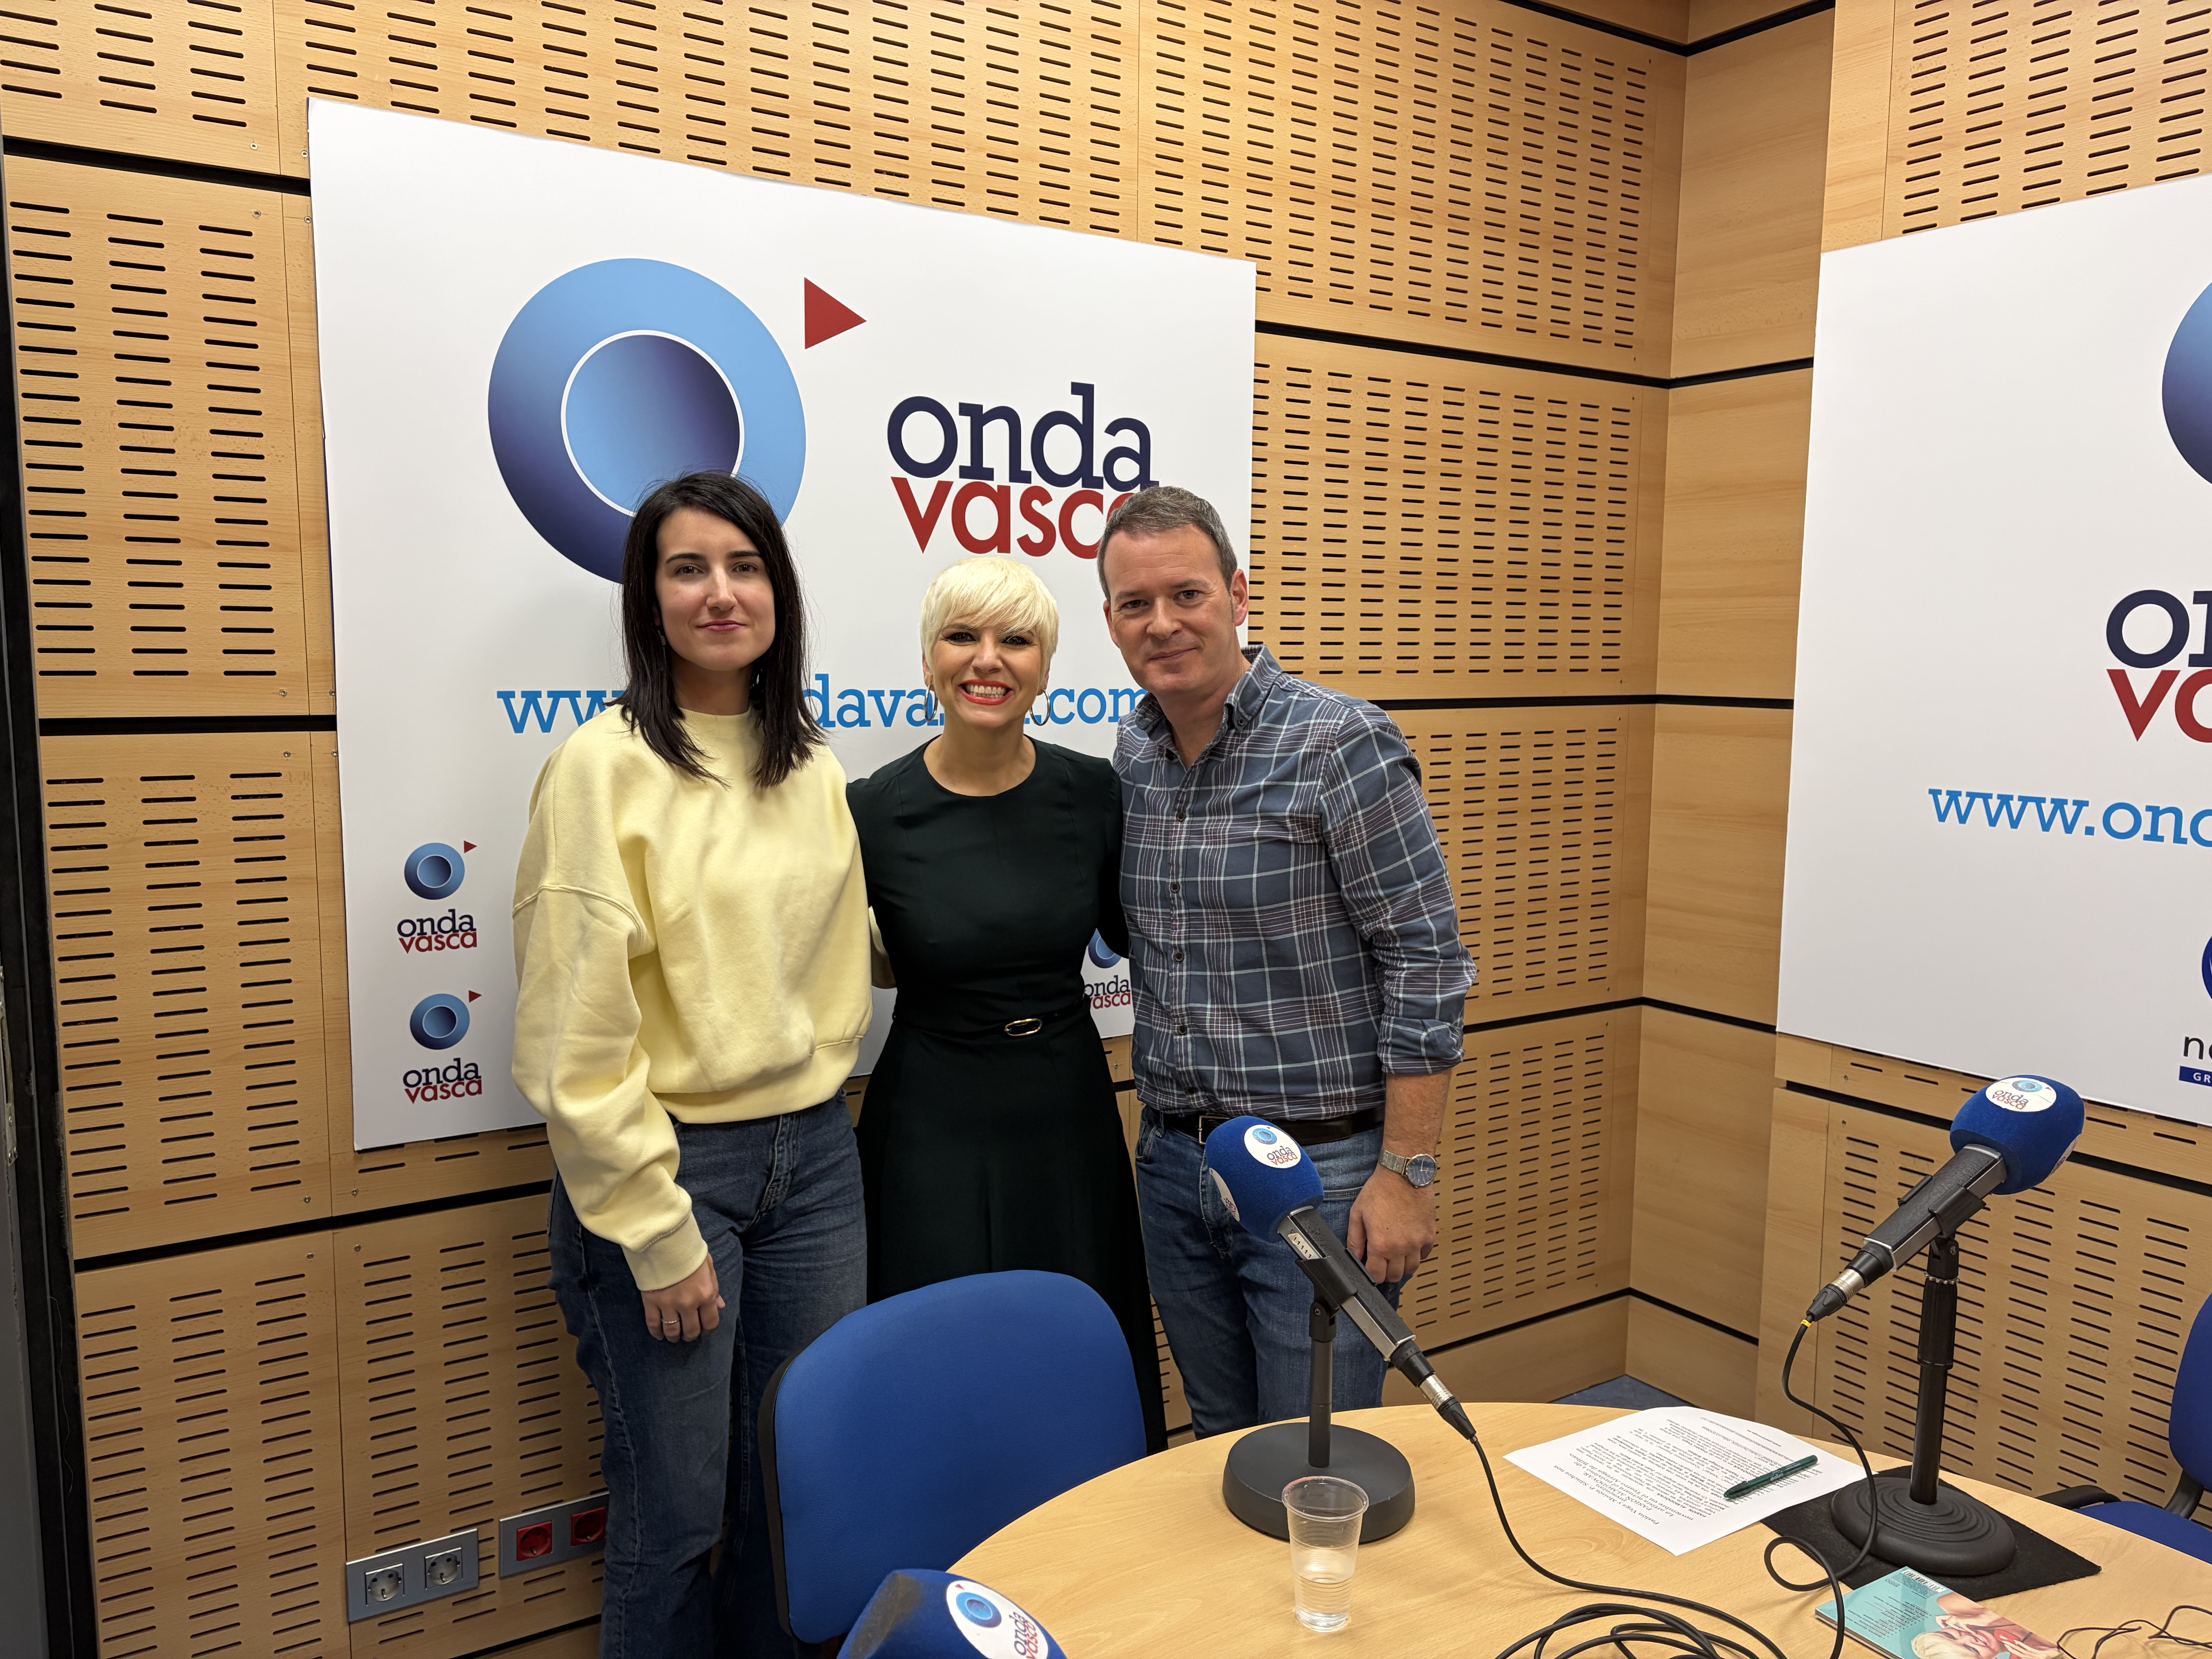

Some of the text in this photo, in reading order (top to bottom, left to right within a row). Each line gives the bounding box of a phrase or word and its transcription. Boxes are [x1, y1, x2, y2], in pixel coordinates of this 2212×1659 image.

[887, 381, 1159, 492] onda
[891, 476, 1135, 559] vasc
[2106, 589, 2212, 668] o
[397, 909, 477, 938] onda
[398, 932, 477, 954] vasca
[1084, 975, 1130, 997] onda
[1090, 992, 1131, 1009] asca
[2183, 1036, 2212, 1060] n
[403, 1058, 481, 1088] onda
[2193, 1072, 2211, 1083] GR
[404, 1080, 482, 1104] vasca
[1995, 1090, 2028, 1105] onda
[1992, 1094, 2027, 1110] vasca
[1267, 1146, 1294, 1160] onda
[1271, 1152, 1298, 1166] vasca
[1570, 1453, 1589, 1465] Bilbao.
[1565, 1472, 1589, 1486] Sánchez
[1597, 1470, 1621, 1482] Arriaga
[1583, 1472, 1652, 1510] PASIÓN ALMODÓVAR.
[1595, 1490, 1617, 1502] Moisés
[1596, 1484, 1629, 1501] presentan
[1621, 1483, 1641, 1495] Teatro
[1622, 1504, 1637, 1513] Vega
[1658, 1503, 1693, 1520] noviembre
[1638, 1513, 1659, 1525] Pasión
[1009, 1612, 1027, 1656] onda
[1026, 1620, 1038, 1659] vasca
